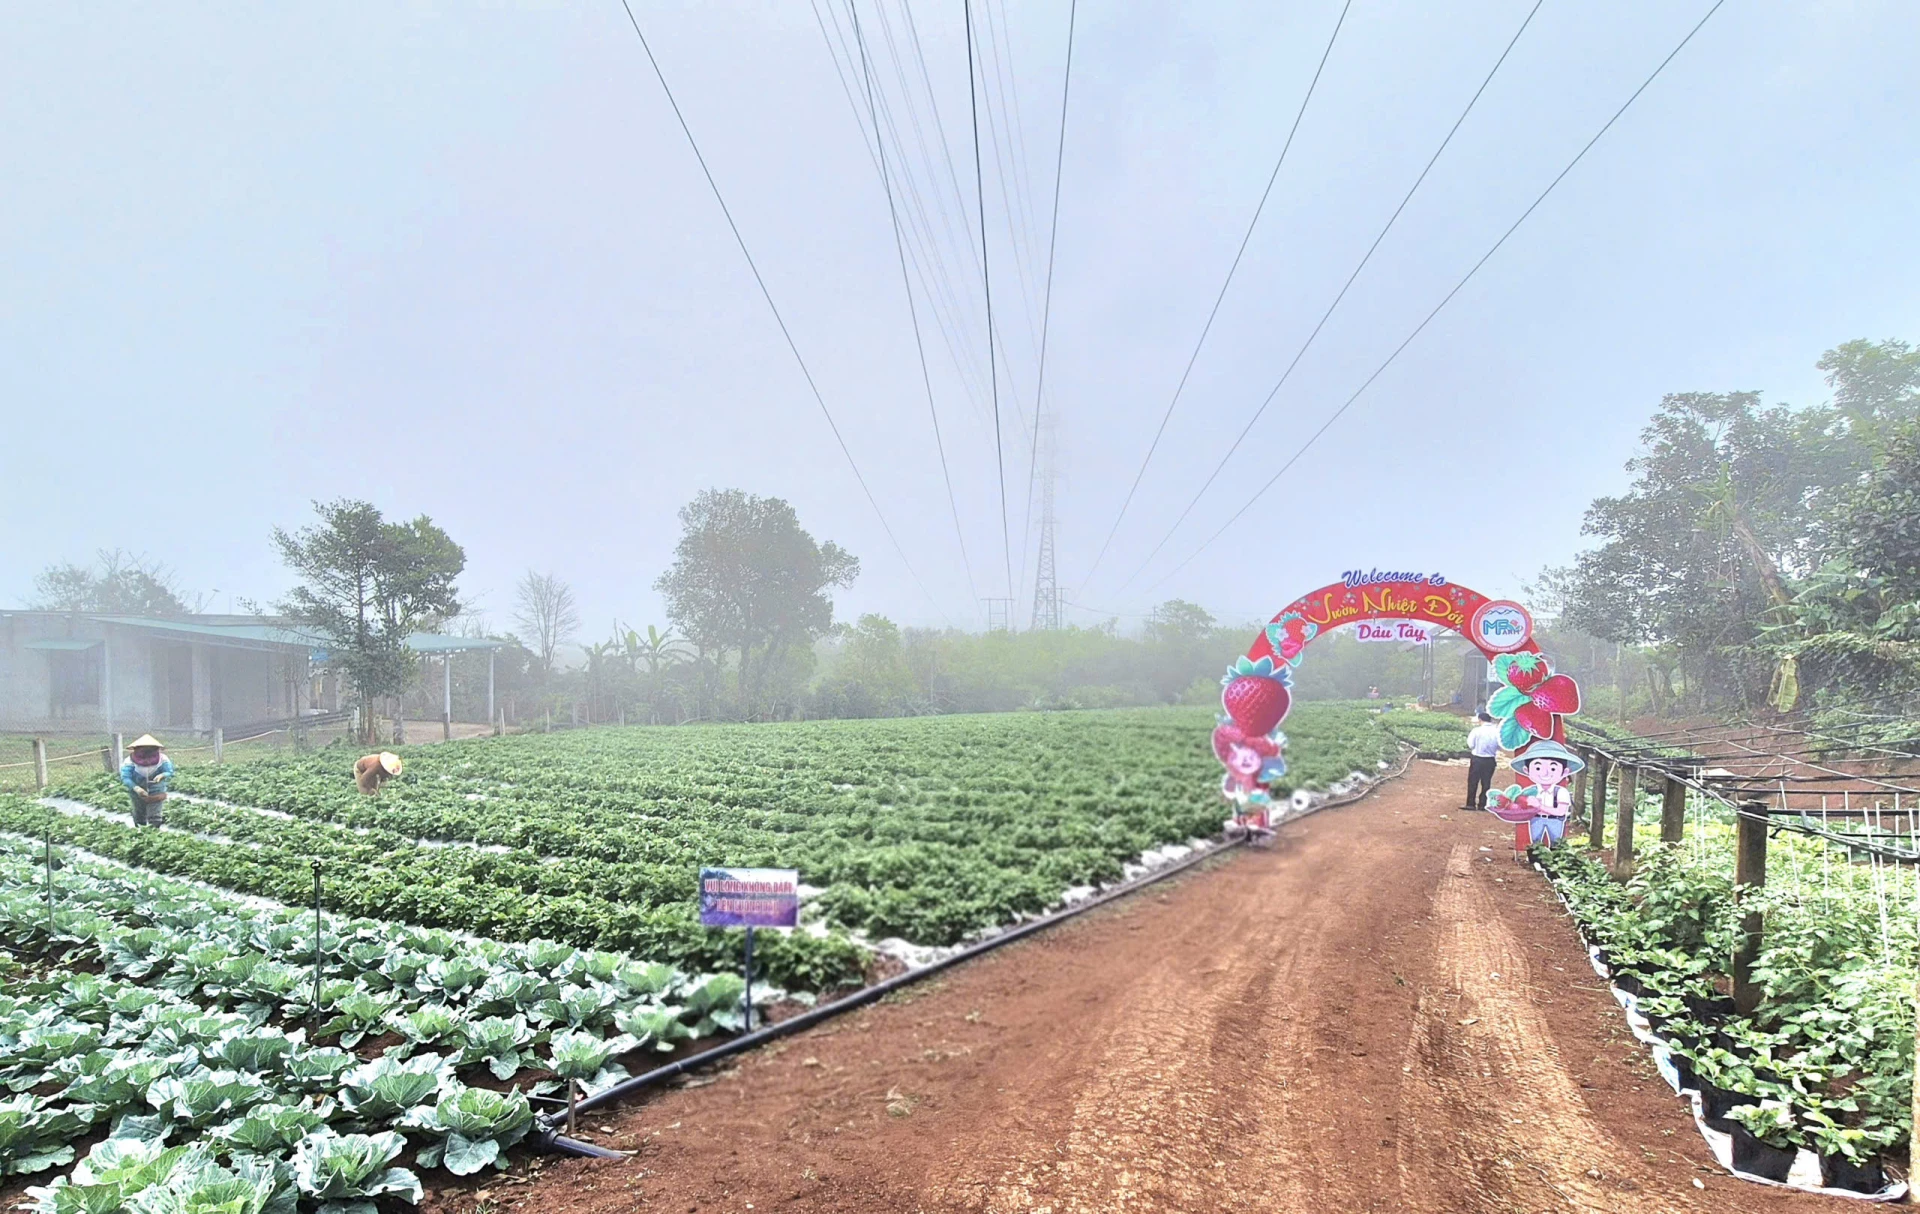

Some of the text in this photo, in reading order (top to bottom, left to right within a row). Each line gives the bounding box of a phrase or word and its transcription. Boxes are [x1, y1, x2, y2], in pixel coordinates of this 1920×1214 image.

[1429, 572, 1446, 585] to
[1362, 587, 1417, 614] Nhiệt
[1423, 595, 1464, 625] Đới
[1357, 623, 1428, 642] Dâu Tây
